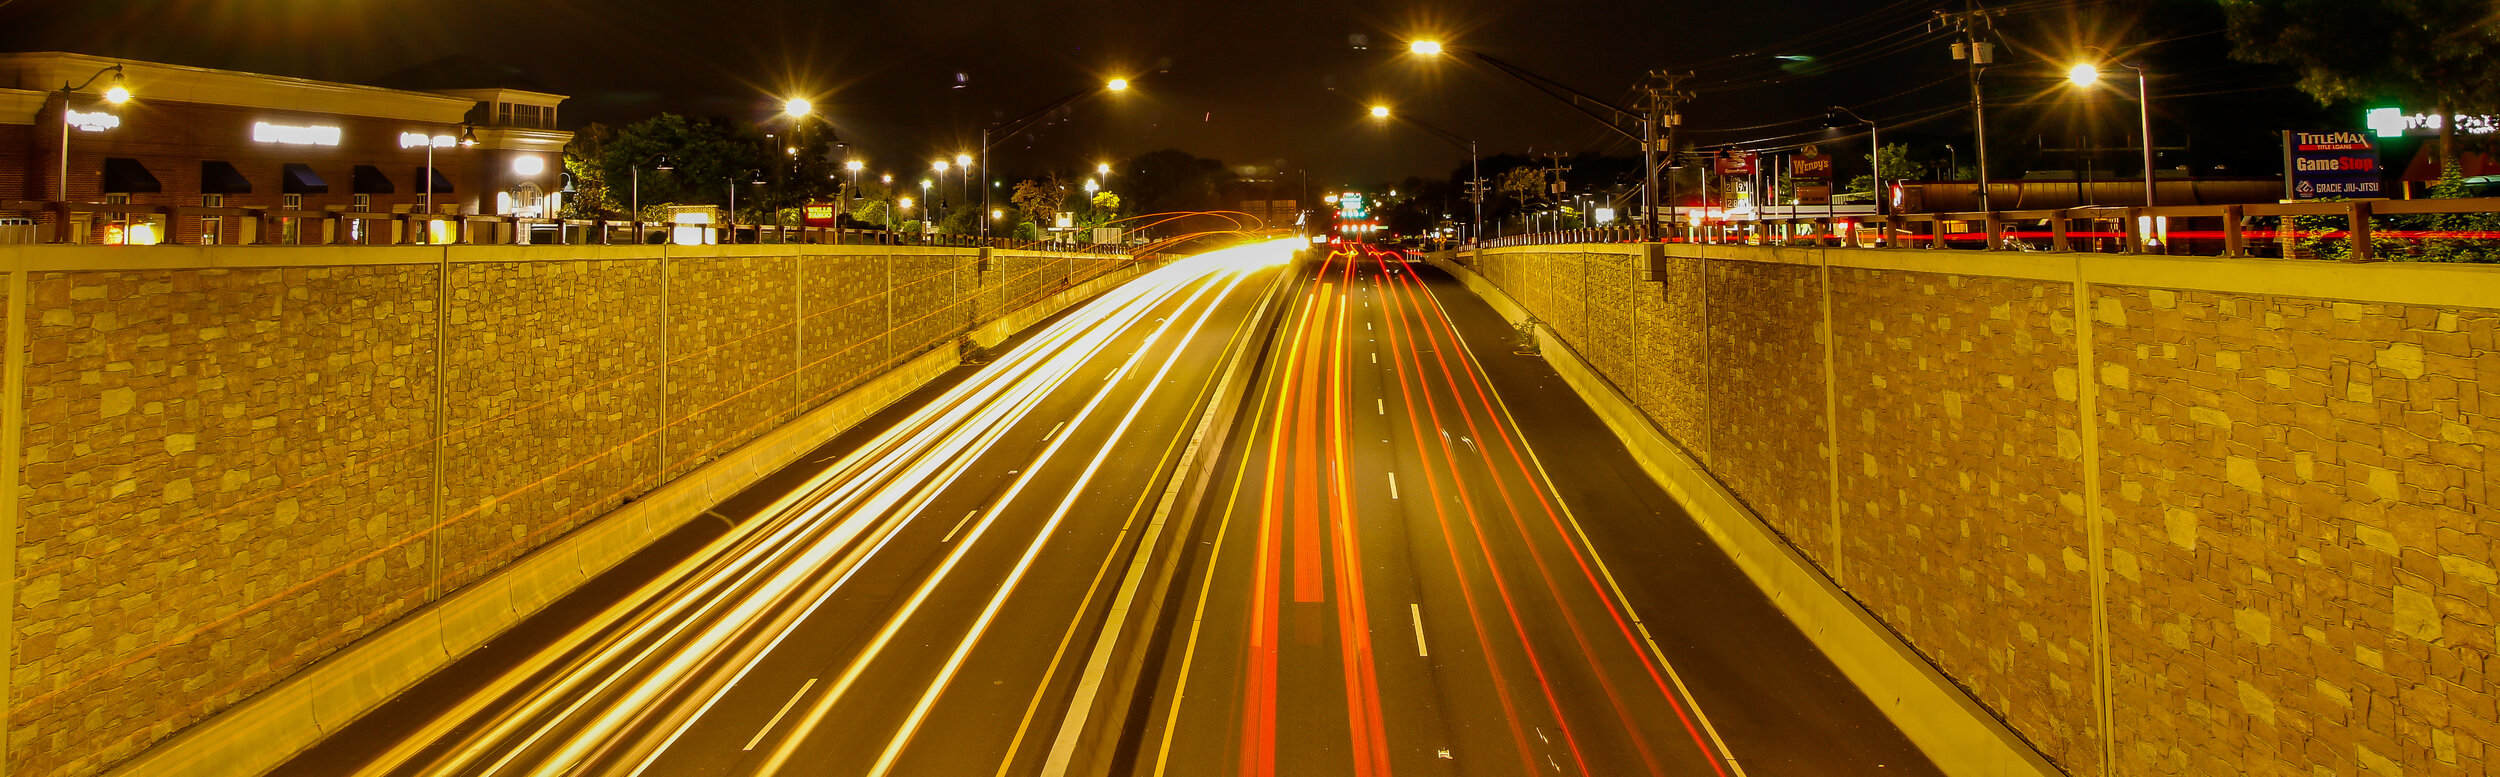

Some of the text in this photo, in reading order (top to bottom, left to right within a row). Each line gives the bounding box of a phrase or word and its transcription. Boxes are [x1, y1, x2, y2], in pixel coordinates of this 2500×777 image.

[2296, 156, 2373, 172] GameStop
[2316, 182, 2379, 193] GRACIE JIU-JITSU
